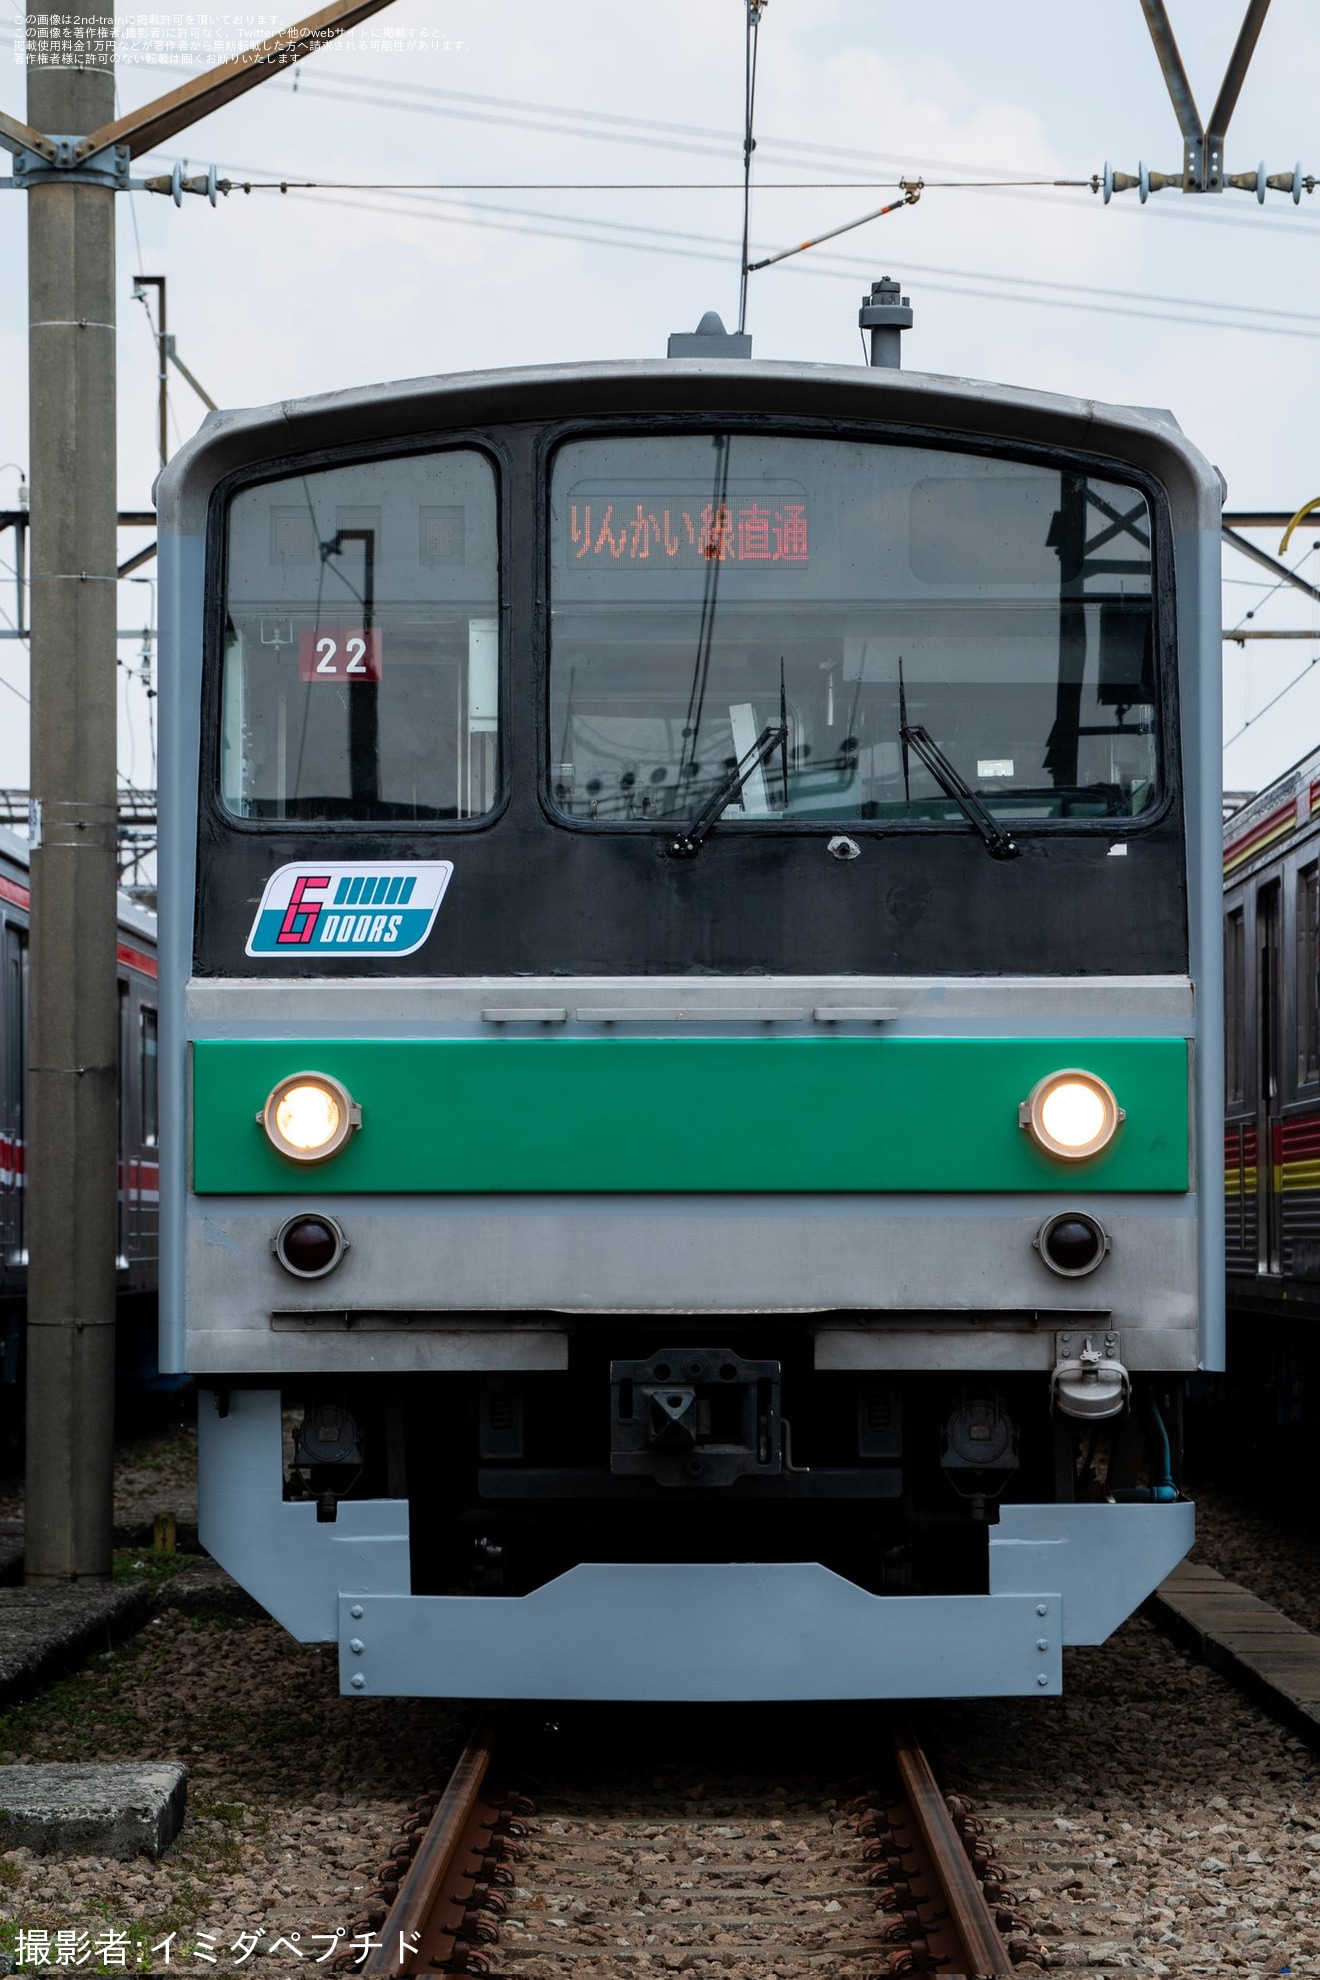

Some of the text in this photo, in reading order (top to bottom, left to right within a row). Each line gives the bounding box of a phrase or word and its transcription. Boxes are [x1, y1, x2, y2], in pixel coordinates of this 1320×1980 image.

[571, 503, 809, 560] りんかい線直通
[316, 637, 366, 673] 22
[276, 876, 331, 944] 6
[320, 915, 402, 943] DOORS
